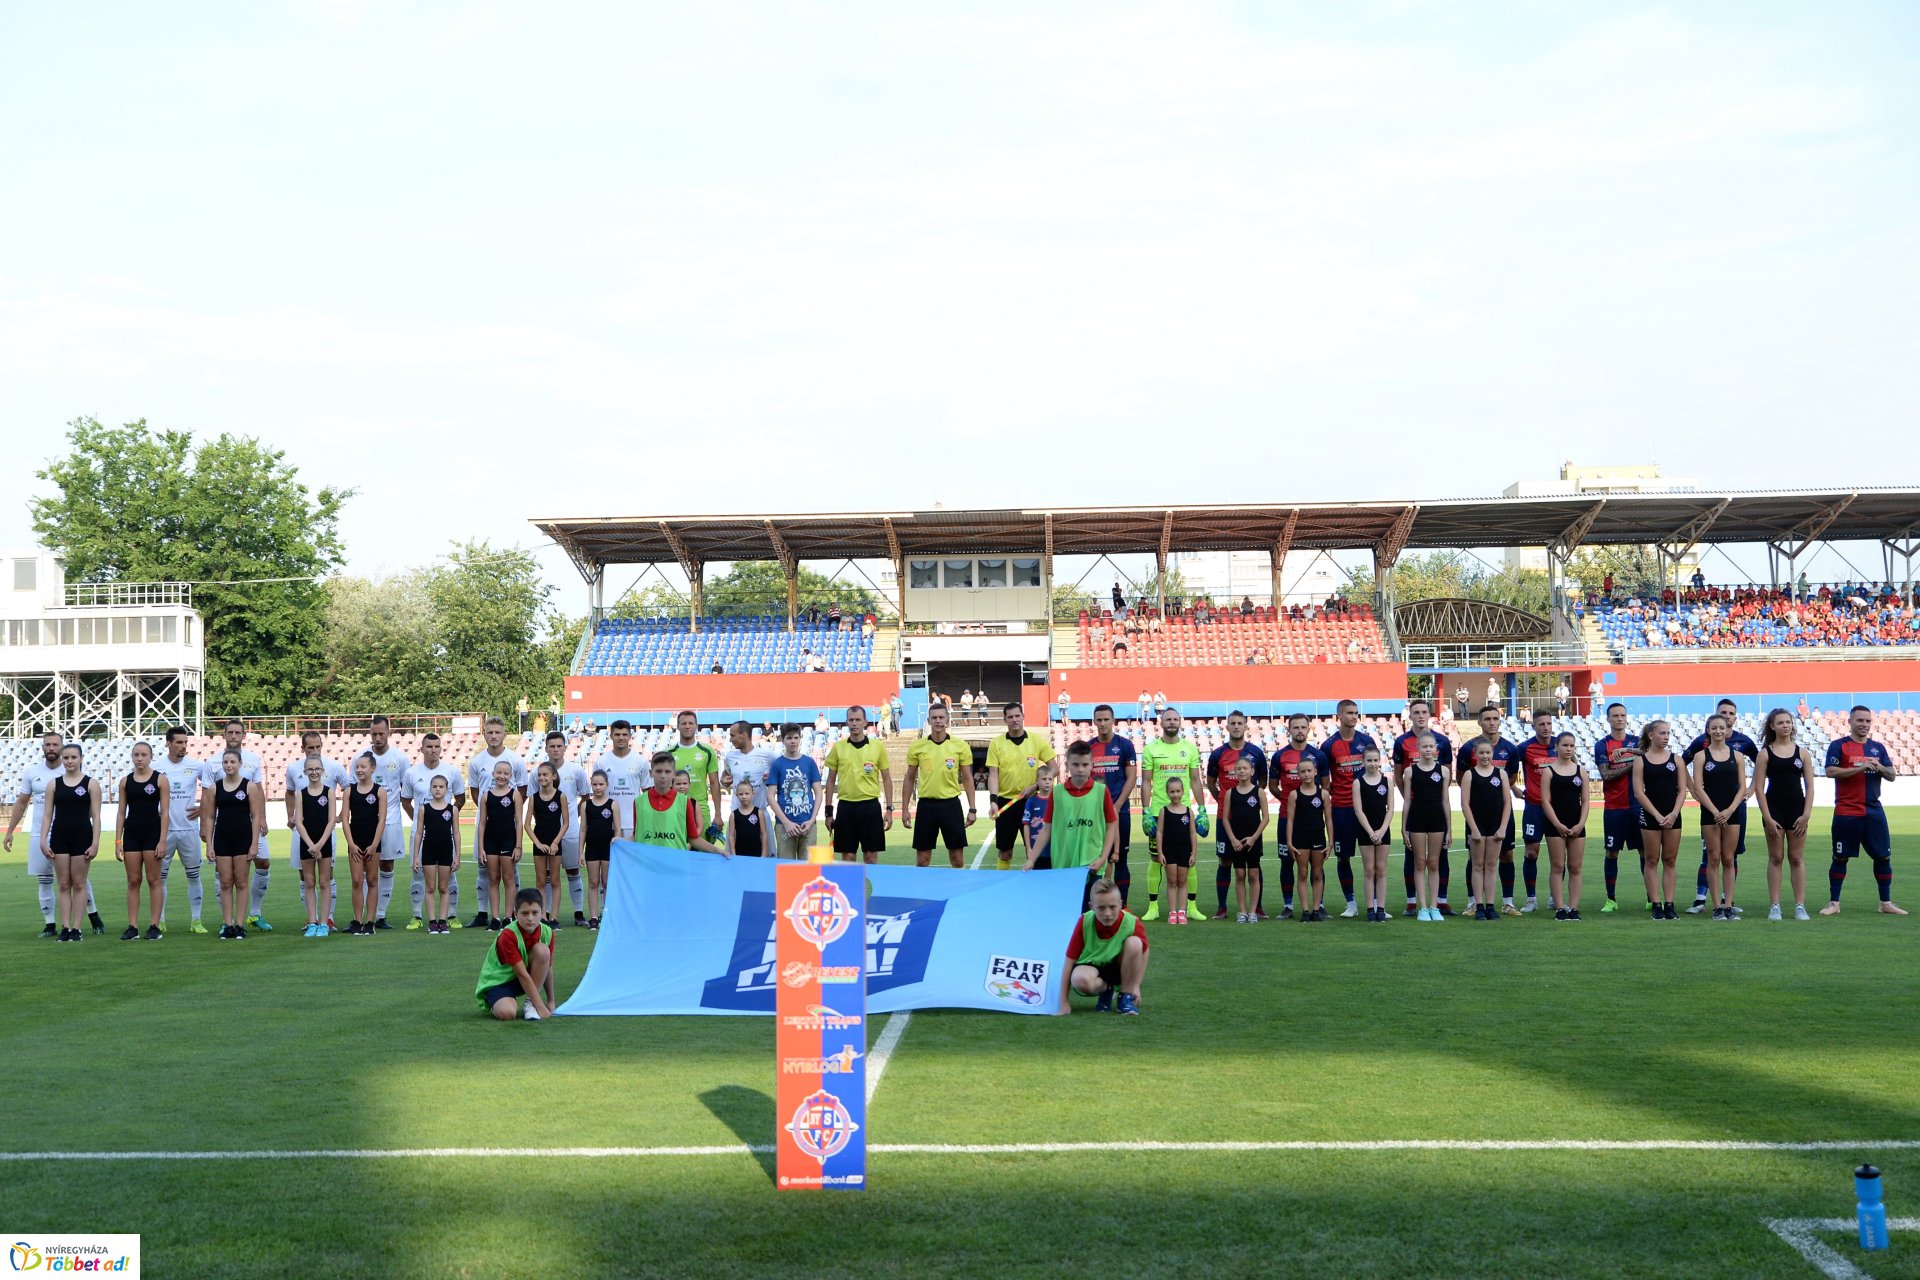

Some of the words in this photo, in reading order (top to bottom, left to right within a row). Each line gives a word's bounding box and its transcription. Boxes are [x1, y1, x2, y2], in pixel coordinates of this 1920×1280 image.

[653, 832, 676, 840] JAKO
[1607, 836, 1614, 847] 3
[1836, 841, 1843, 853] 9
[993, 957, 1045, 973] FAIR
[991, 967, 1043, 984] PLAY
